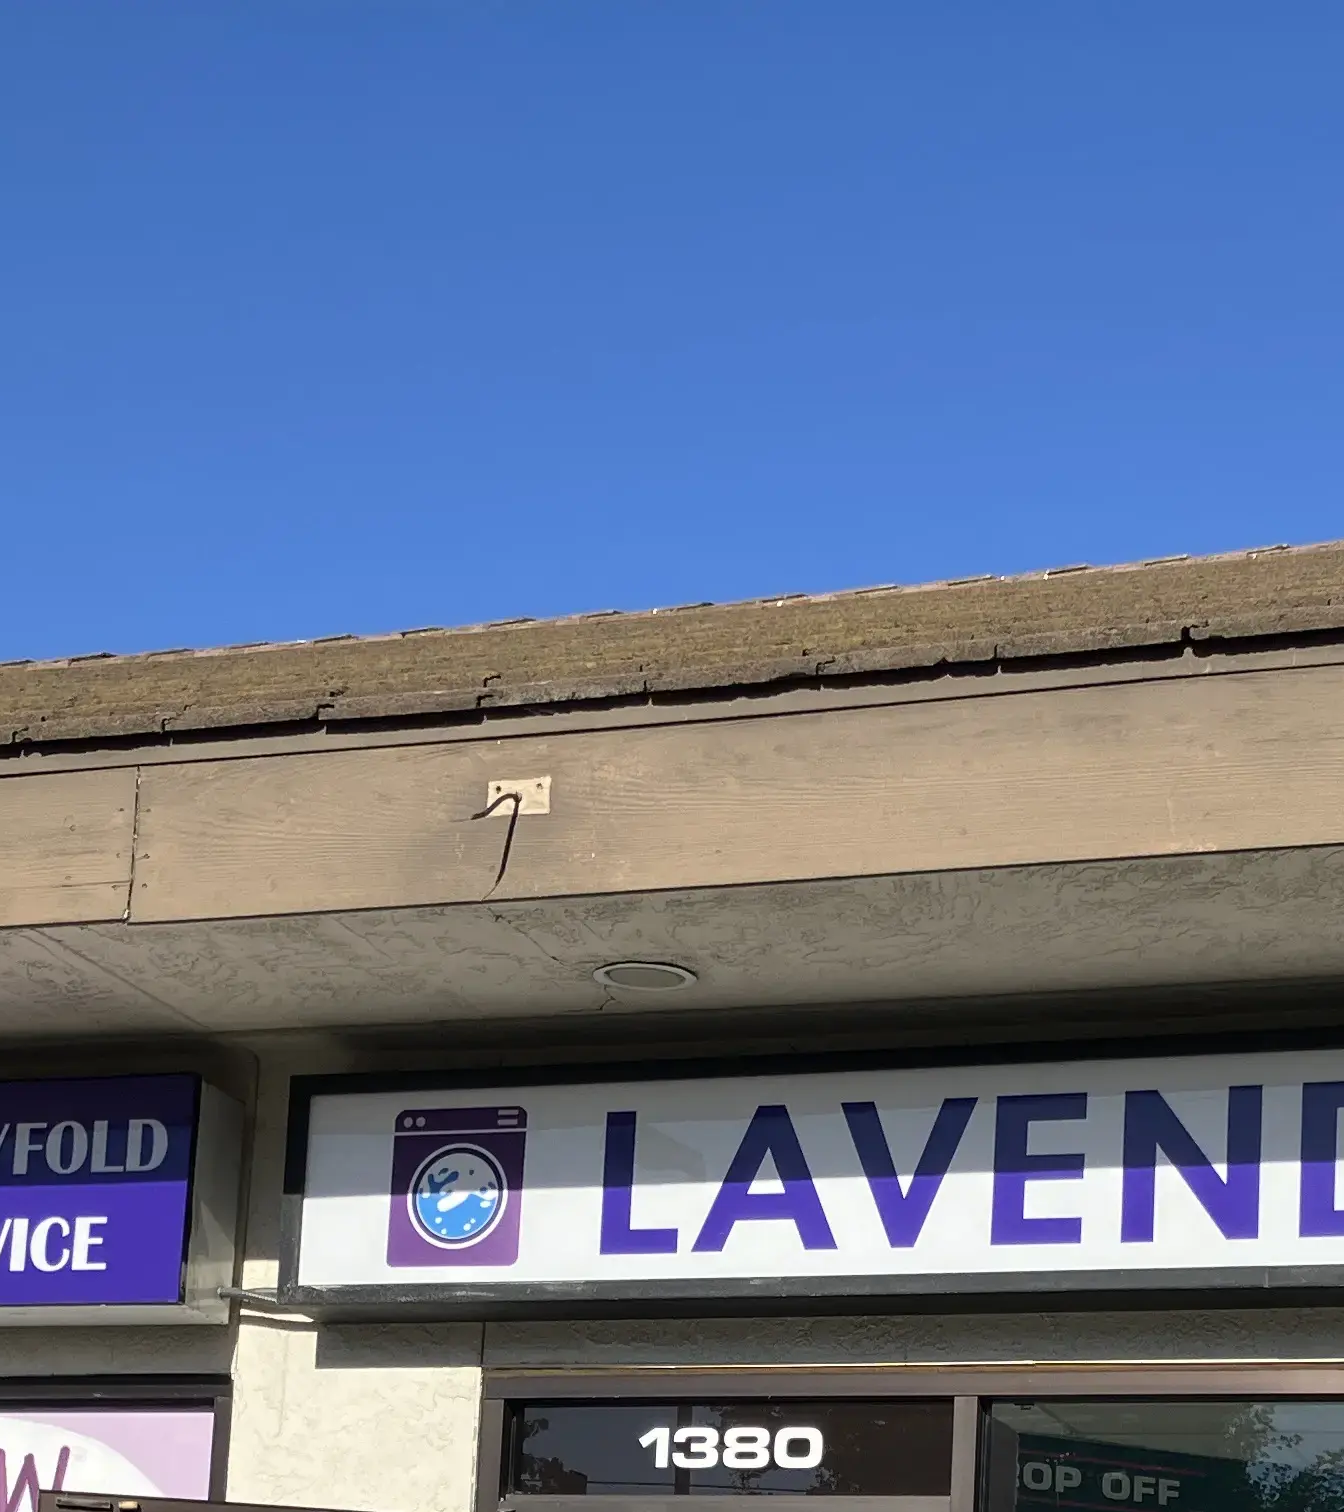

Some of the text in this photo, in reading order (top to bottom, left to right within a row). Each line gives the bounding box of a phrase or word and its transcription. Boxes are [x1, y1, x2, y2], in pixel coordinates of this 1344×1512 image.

[638, 1426, 824, 1469] 1380
[1016, 1461, 1181, 1506] OP OFF
